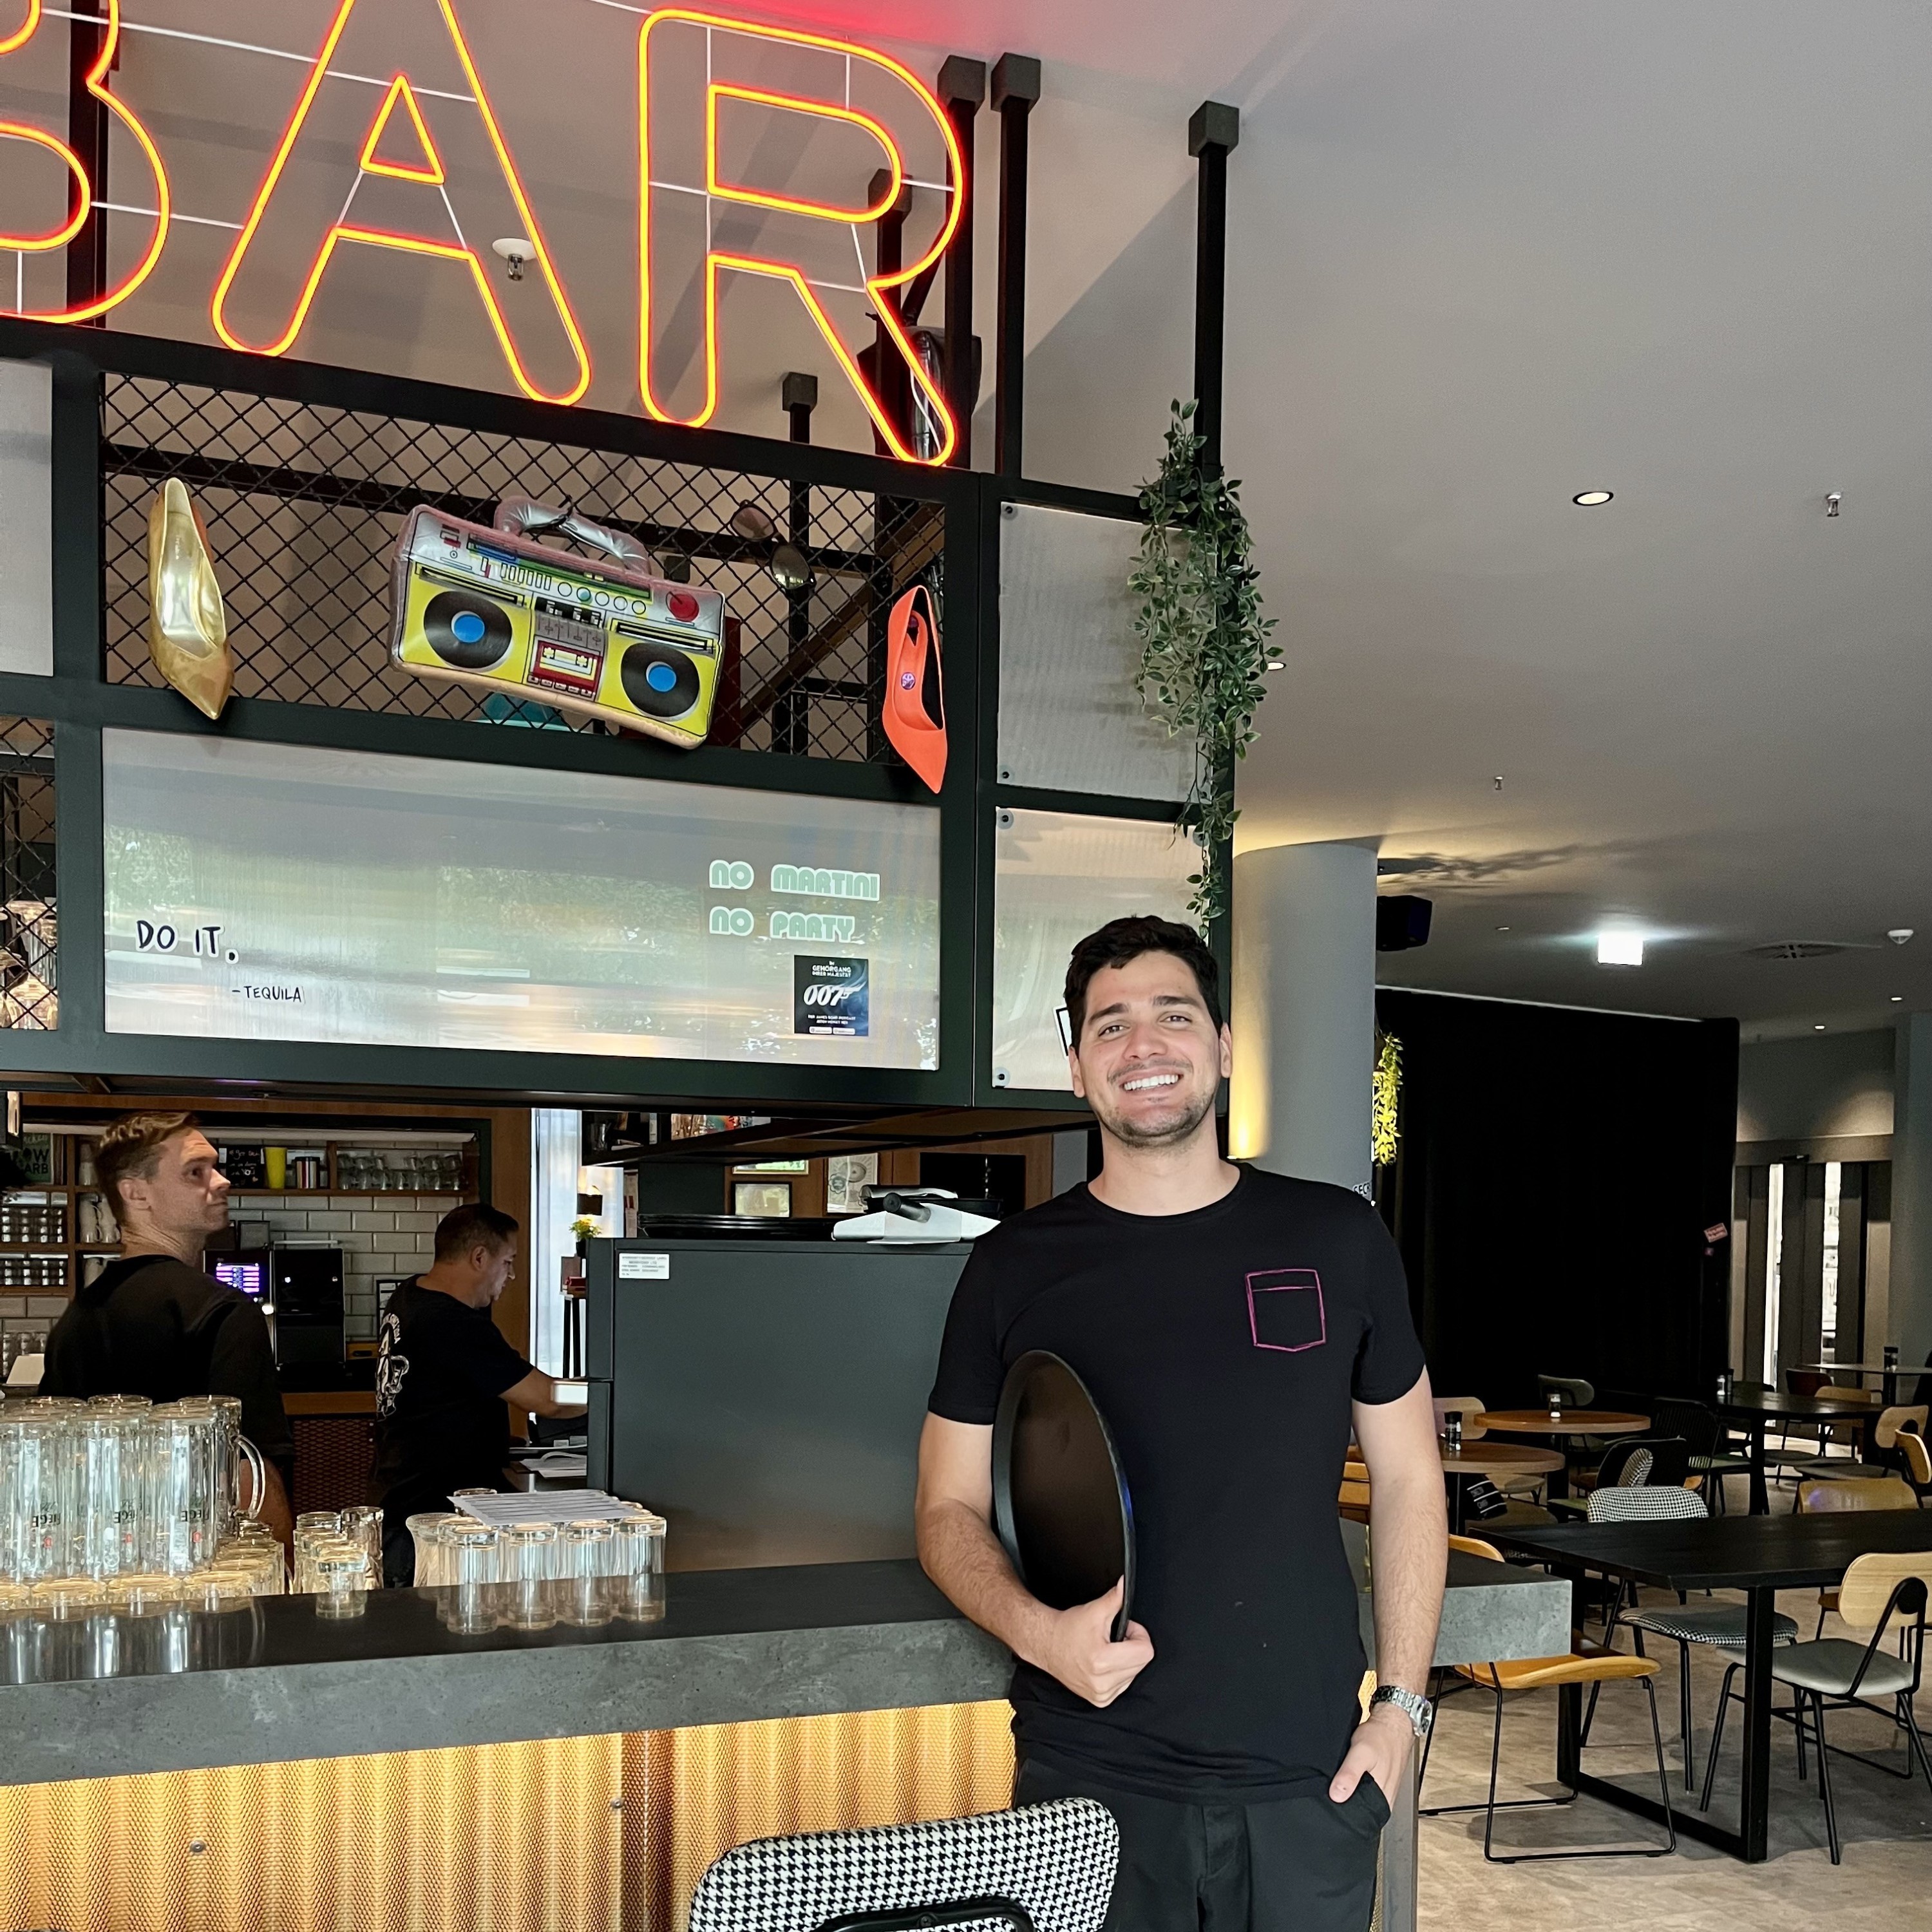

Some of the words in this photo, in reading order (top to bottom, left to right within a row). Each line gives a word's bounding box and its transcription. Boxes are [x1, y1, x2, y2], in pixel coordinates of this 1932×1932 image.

[710, 860, 754, 889] NO
[771, 864, 880, 901] MARTINI
[137, 920, 175, 949] DO
[195, 926, 236, 961] IT.
[710, 906, 754, 936] NO
[770, 911, 855, 943] PARTY
[804, 983, 851, 1006] 007
